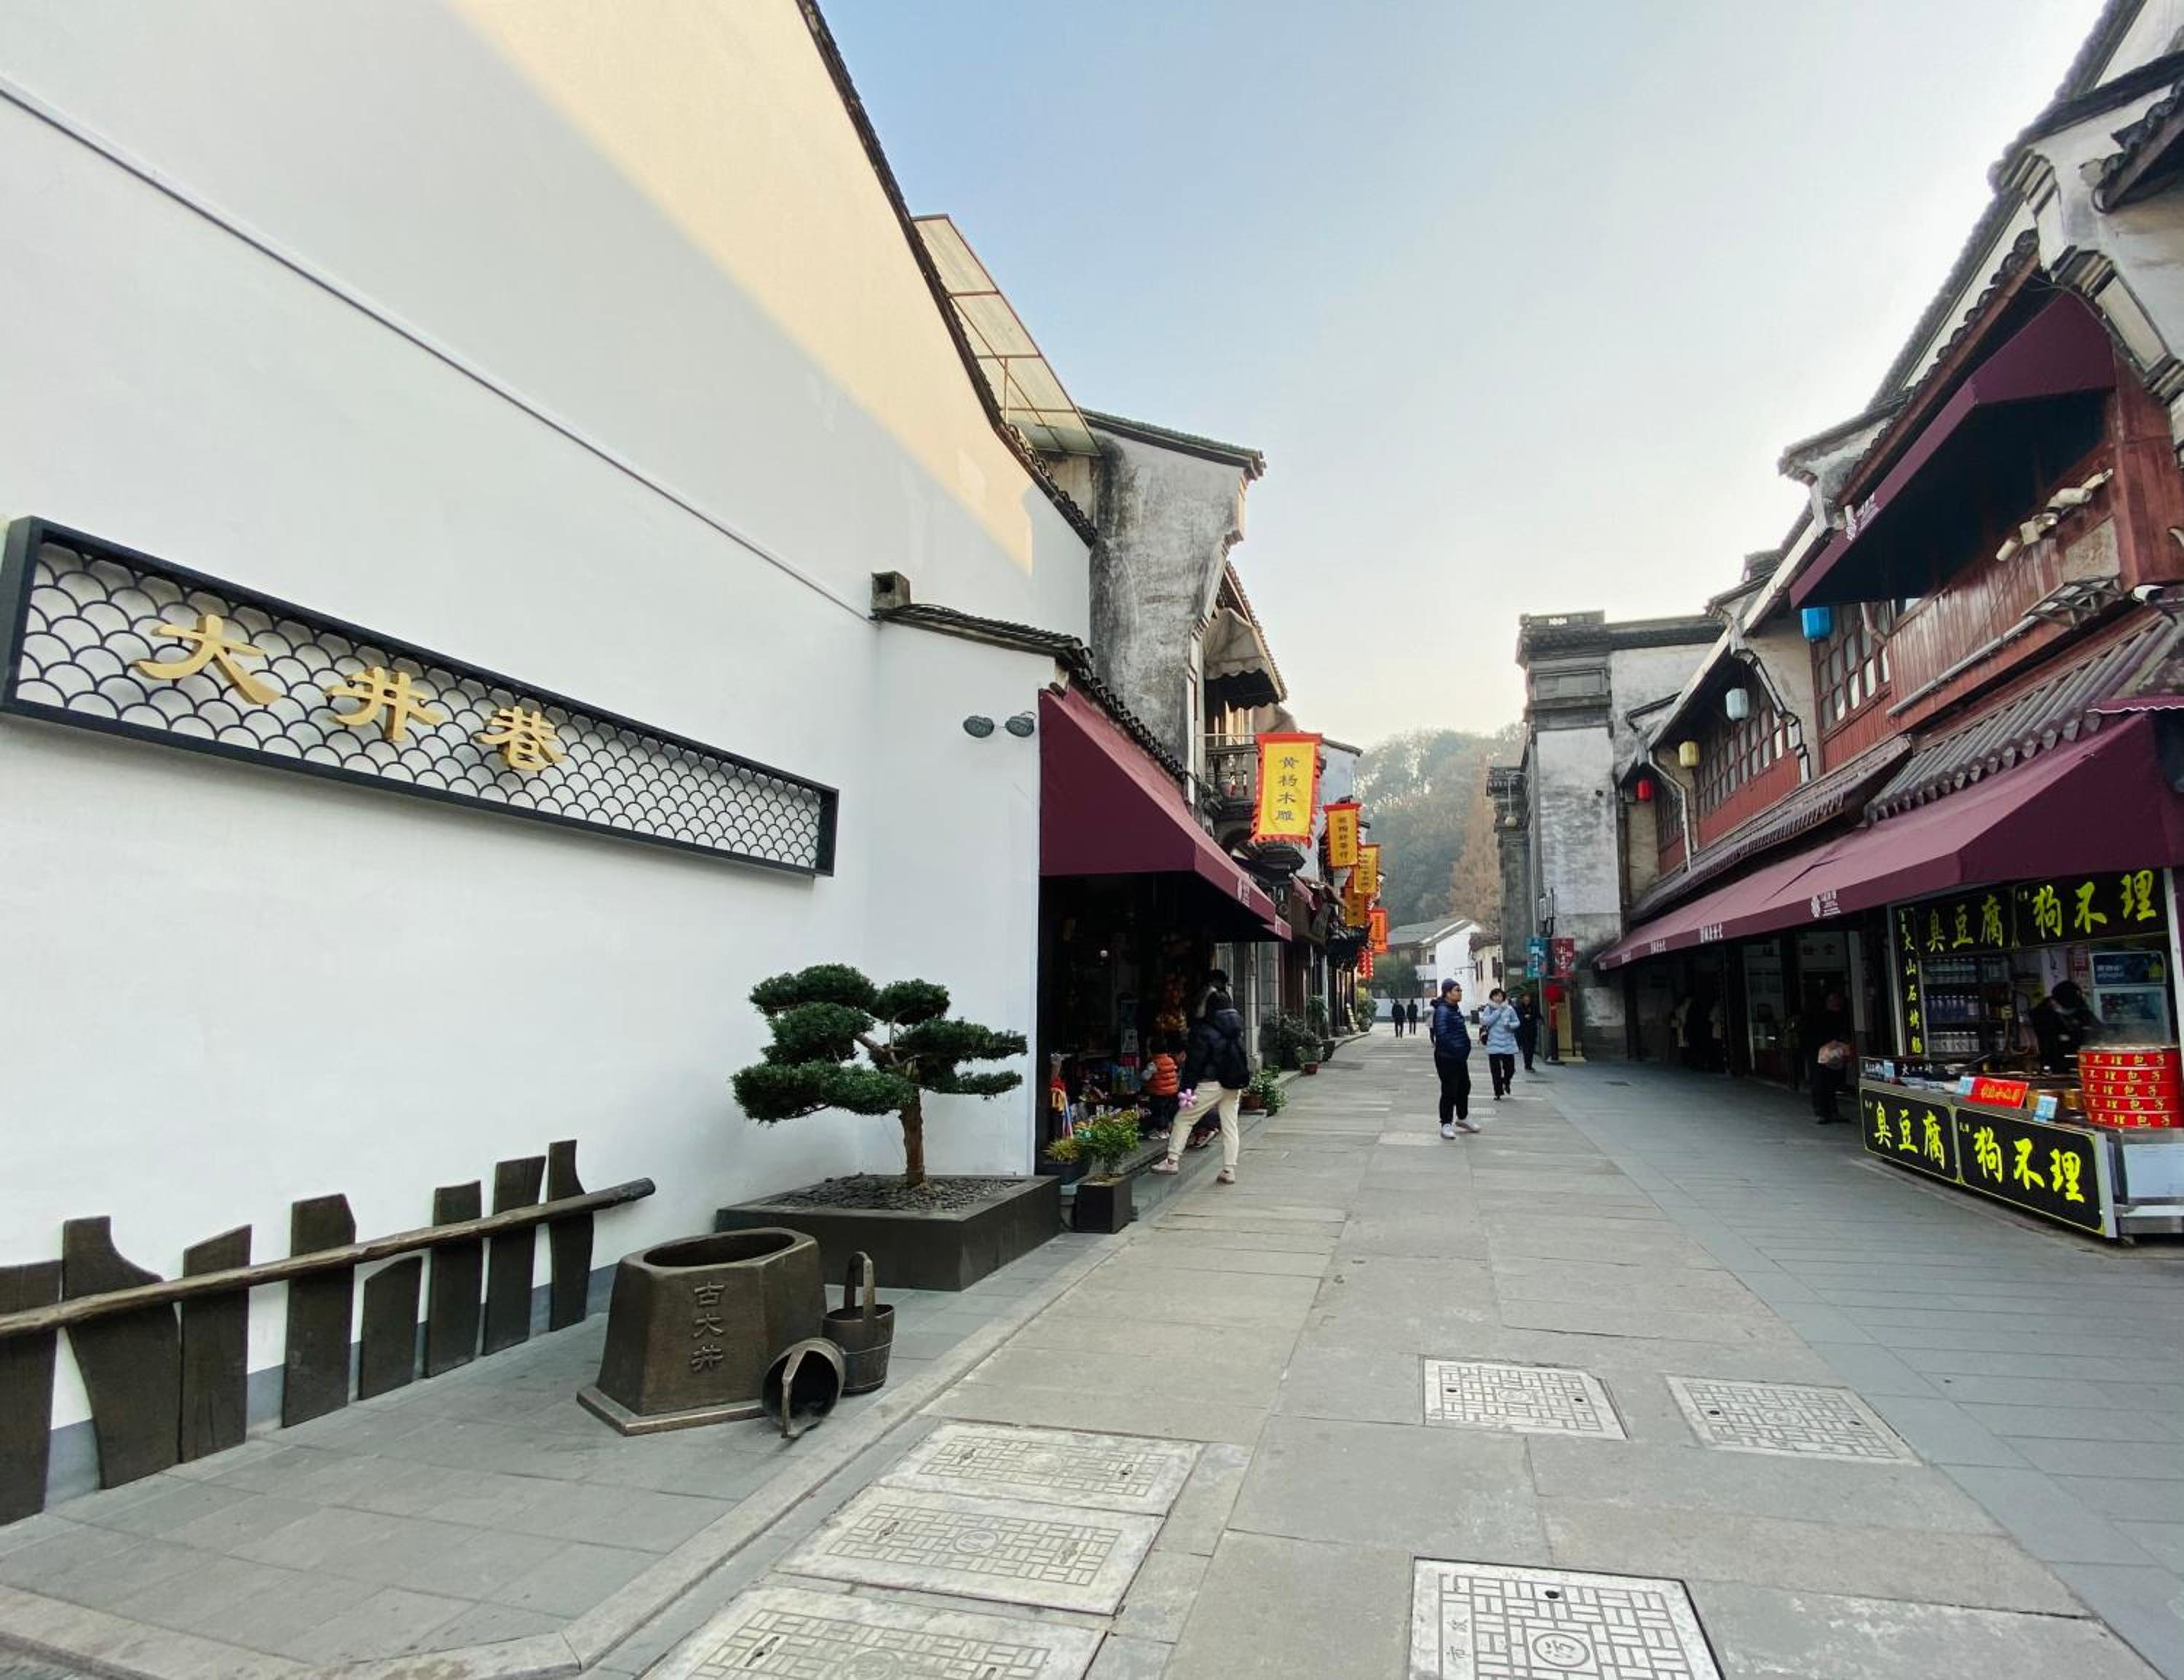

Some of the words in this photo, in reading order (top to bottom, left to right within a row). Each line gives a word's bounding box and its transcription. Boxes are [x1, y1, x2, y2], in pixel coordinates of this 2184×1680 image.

[133, 614, 571, 772] 大井巷
[1927, 895, 2003, 954] 臭豆腐
[2033, 870, 2157, 938] 狗不理
[1873, 1101, 1946, 1170] 臭豆腐
[1974, 1126, 2085, 1203] 狗不理
[689, 1280, 725, 1374] 古大井
